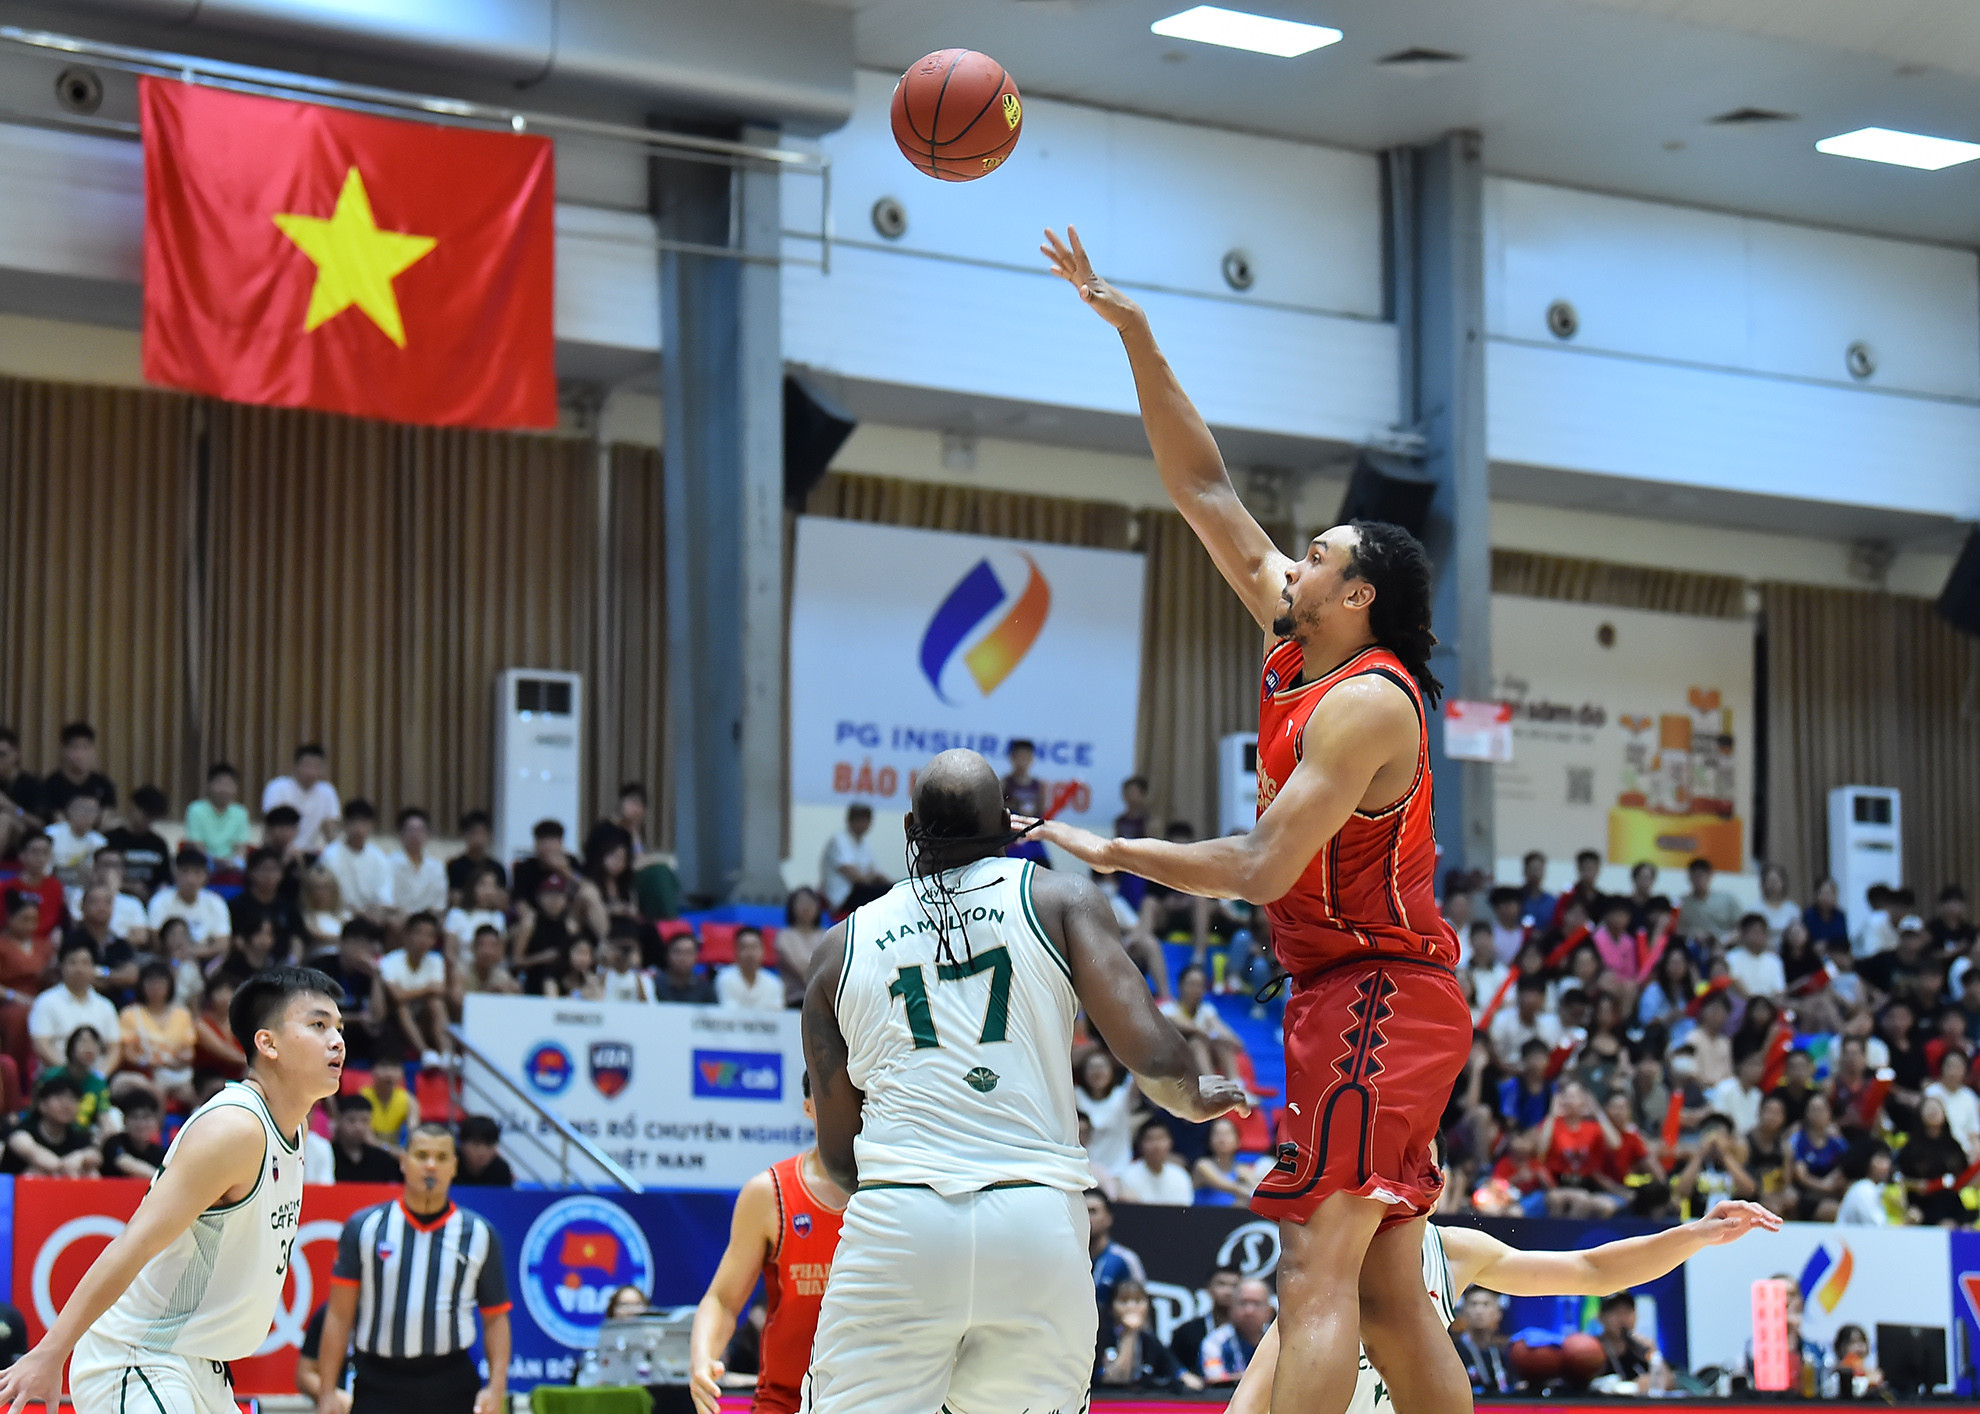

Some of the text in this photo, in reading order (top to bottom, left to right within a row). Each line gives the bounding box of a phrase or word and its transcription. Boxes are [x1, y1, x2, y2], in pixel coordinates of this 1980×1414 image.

[836, 721, 1093, 767] PG INSURNCE
[886, 942, 1014, 1050] 17
